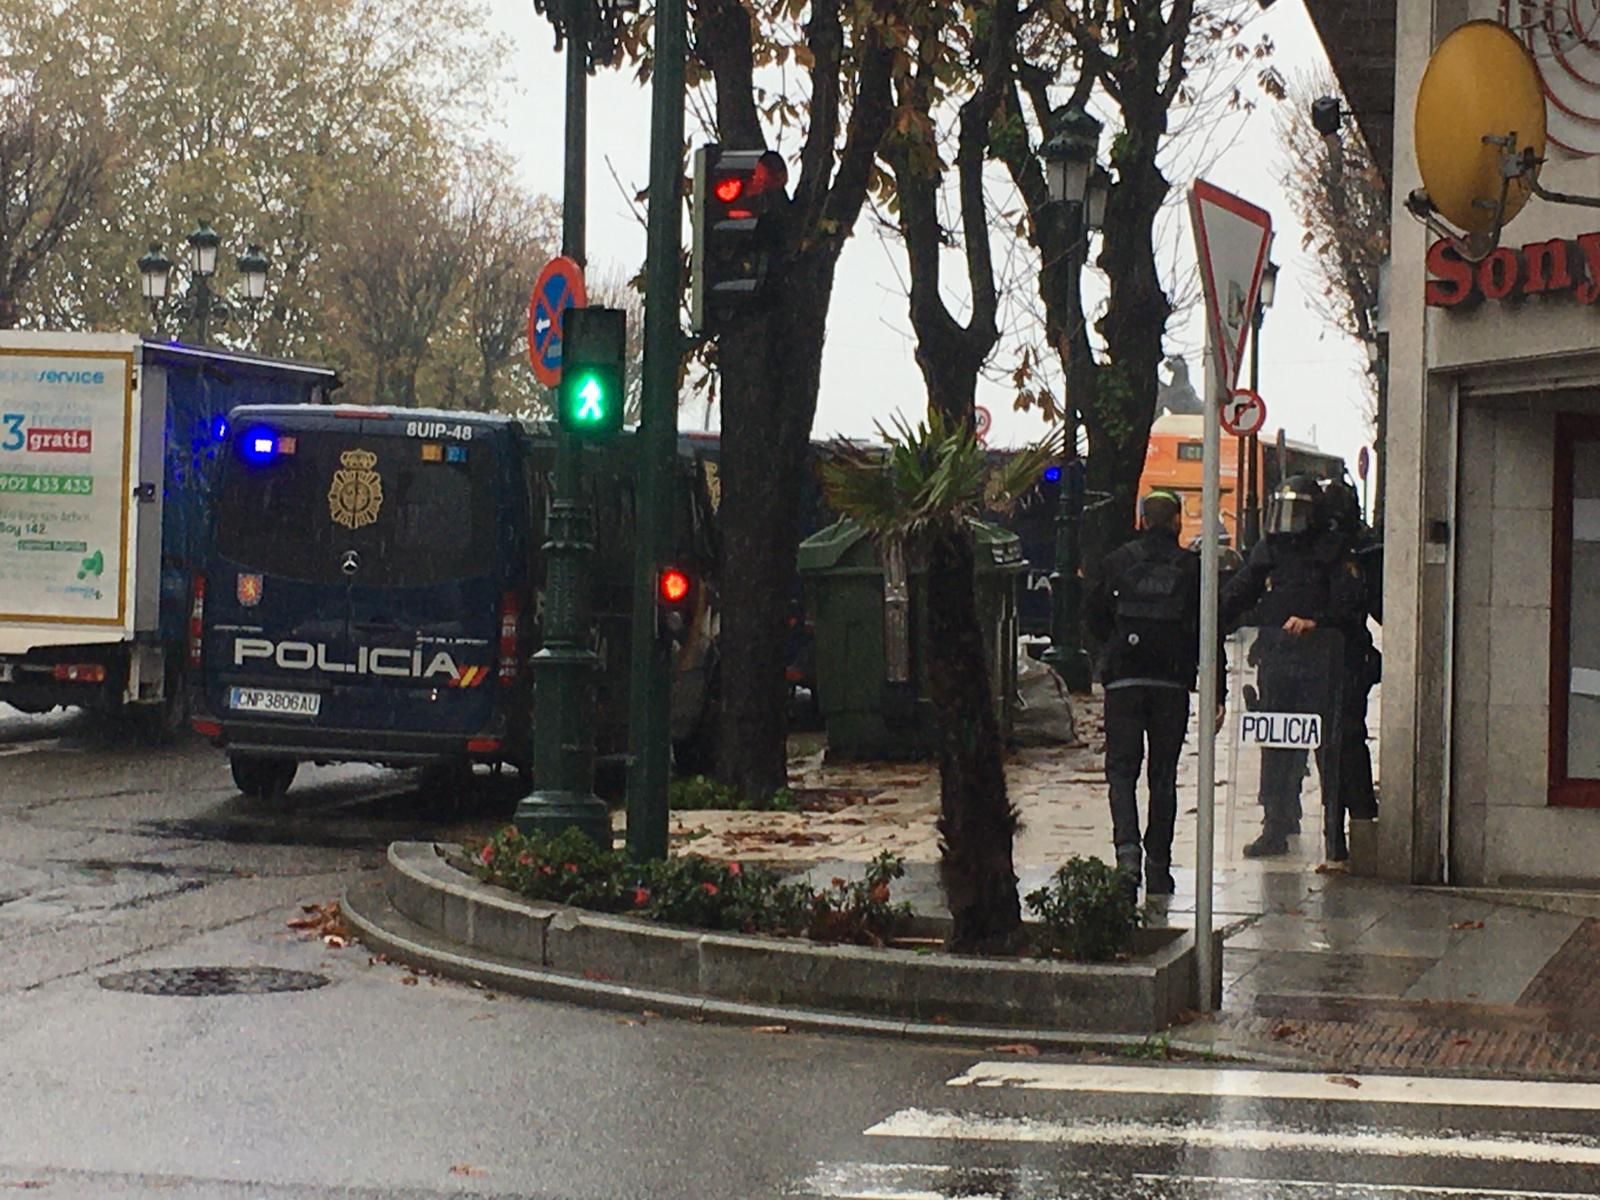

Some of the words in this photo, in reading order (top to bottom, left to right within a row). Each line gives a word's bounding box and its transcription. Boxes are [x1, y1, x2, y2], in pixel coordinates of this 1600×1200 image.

[2, 413, 25, 451] 3
[30, 431, 89, 450] gratis
[406, 421, 472, 441] 8UIP-48
[0, 476, 28, 492] 902
[32, 477, 60, 492] 433
[64, 479, 91, 493] 433
